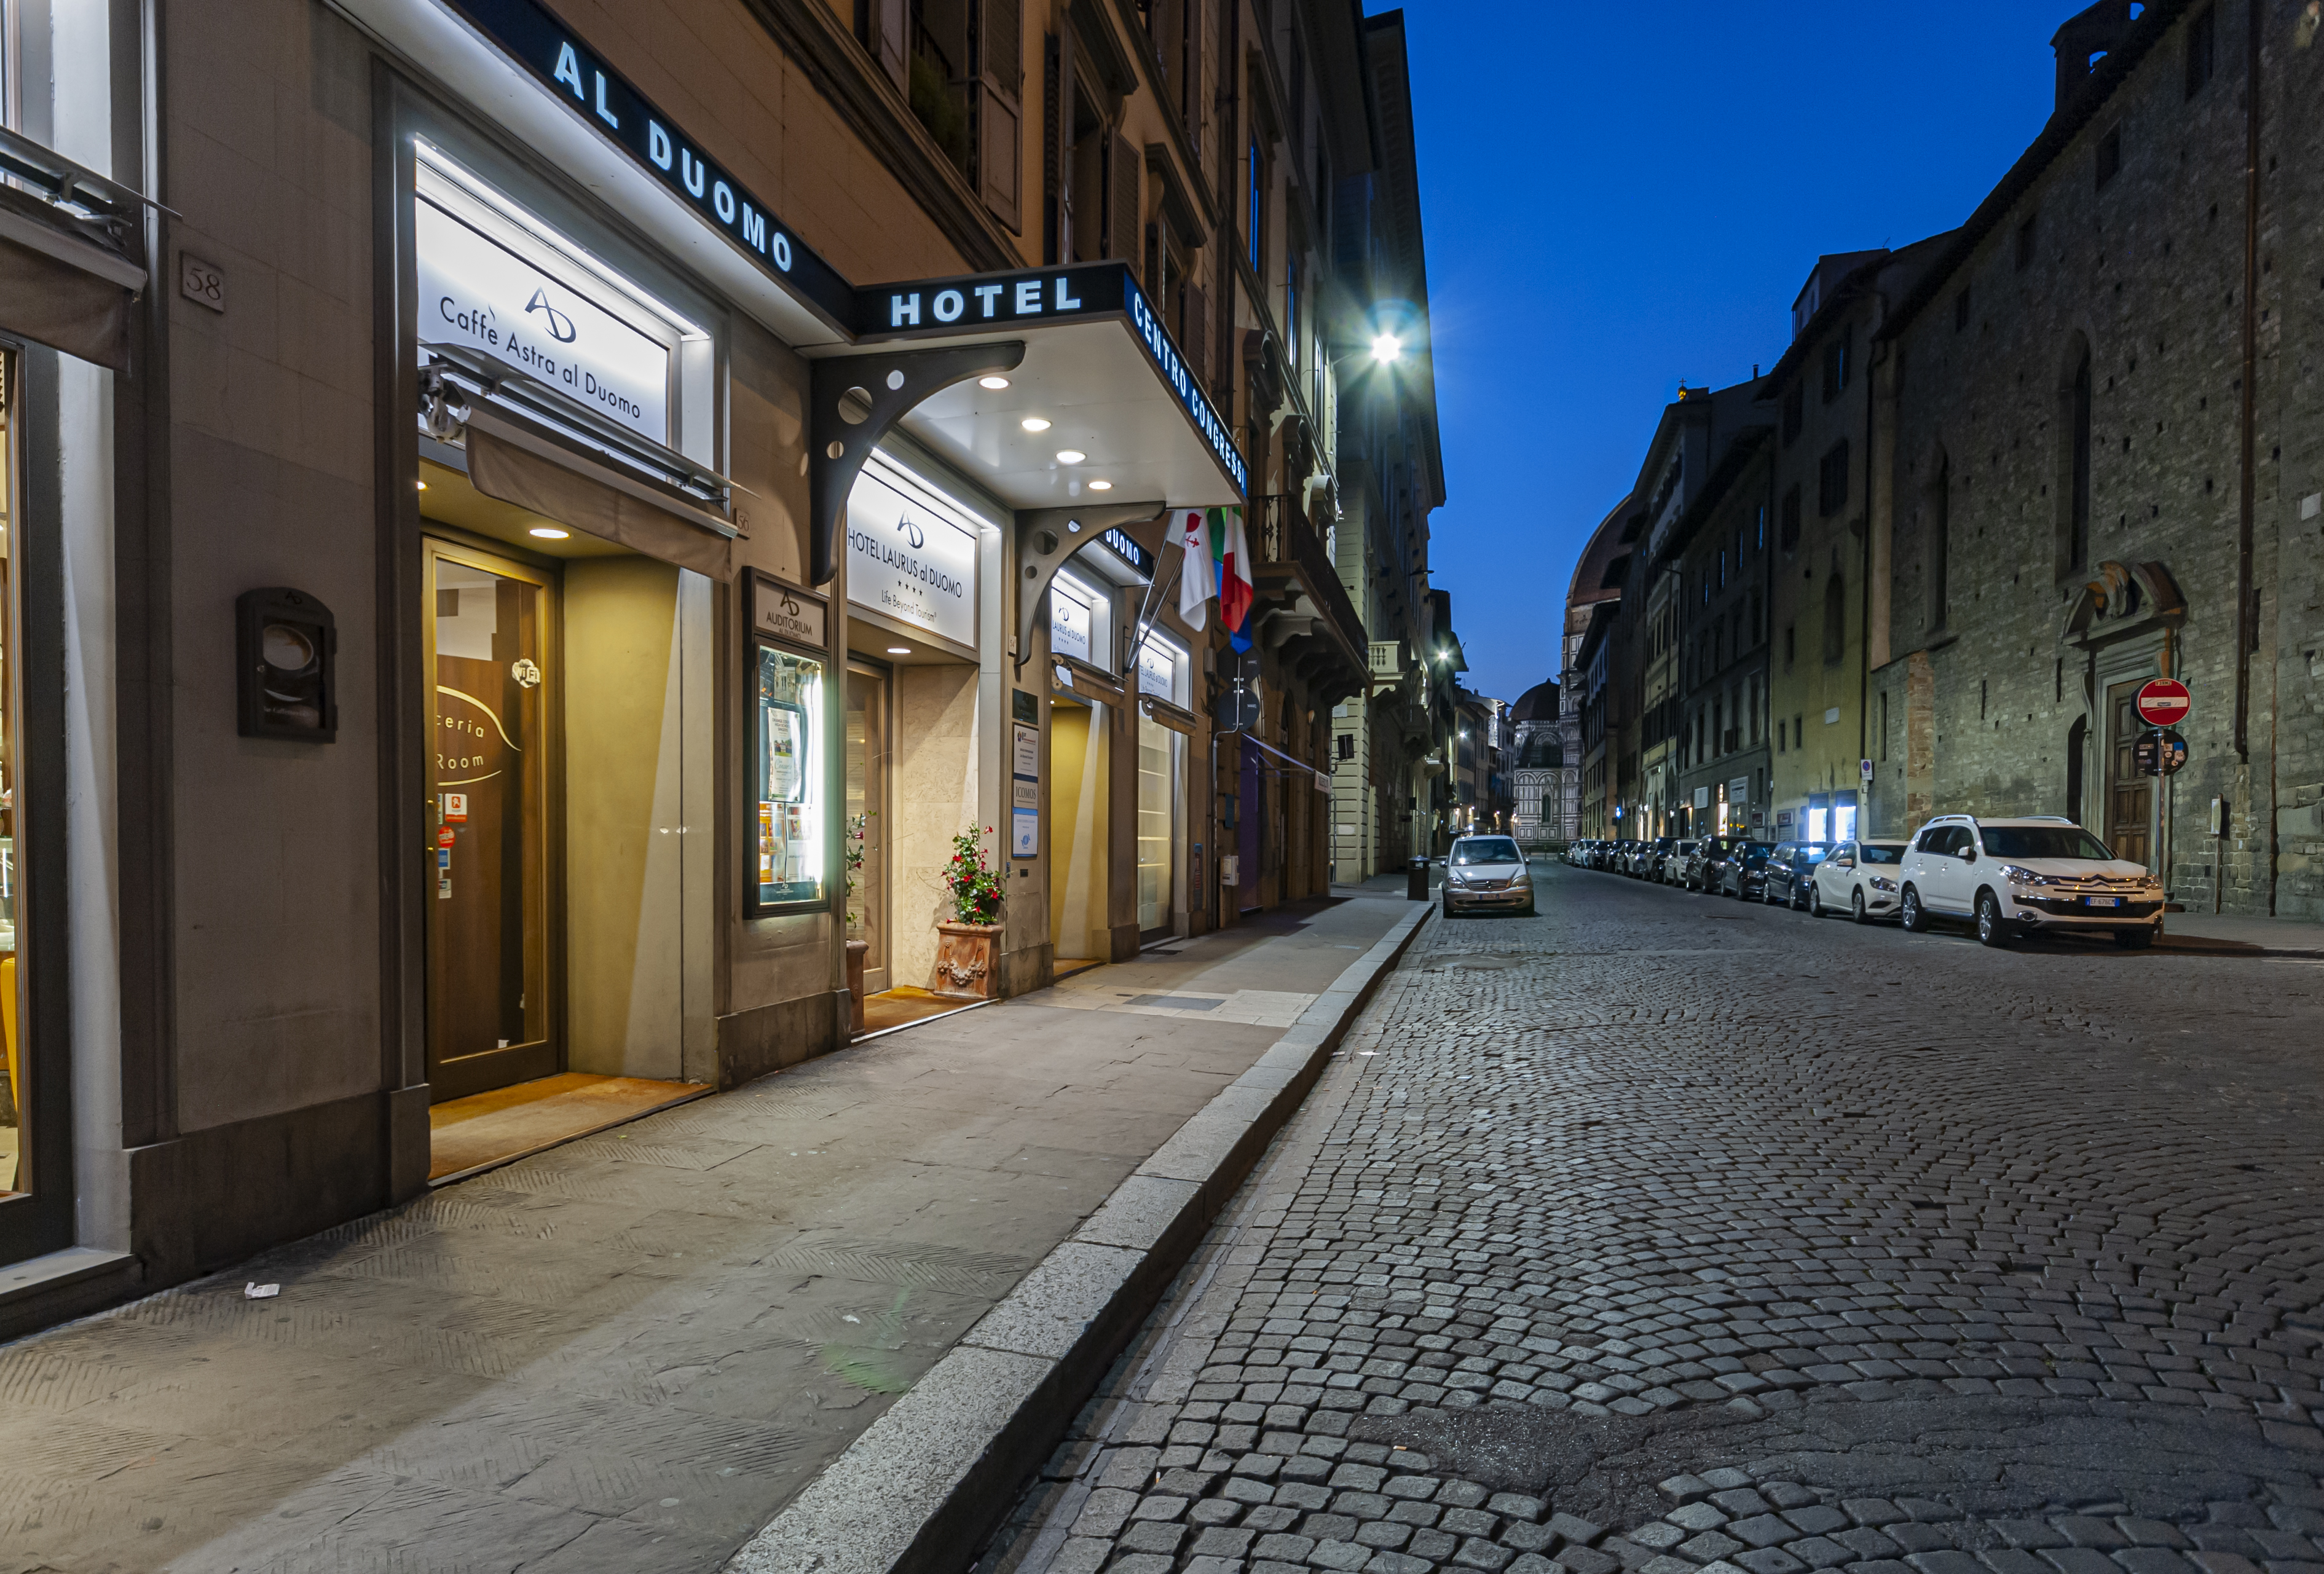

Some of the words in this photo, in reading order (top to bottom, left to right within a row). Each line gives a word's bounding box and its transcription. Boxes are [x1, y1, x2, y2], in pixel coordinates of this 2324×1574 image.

[554, 41, 618, 130] AL
[649, 119, 792, 272] DUOMO
[186, 267, 221, 301] 58
[891, 277, 1081, 327] HOTEL
[440, 296, 498, 345] Caffè
[506, 332, 555, 376] Astra
[563, 364, 578, 387] al
[586, 372, 640, 419] Duomo
[1134, 292, 1186, 397] CENTRO
[1192, 388, 1244, 489] CONGRESSI
[738, 515, 750, 532] 56
[848, 527, 880, 561] HOTEL
[883, 545, 918, 578] LAURUS
[920, 564, 928, 583] al
[930, 568, 963, 598] DUOMO
[881, 589, 891, 605] Life
[893, 594, 915, 613] Beyond
[766, 612, 813, 636] AUDITORIUM
[1052, 620, 1067, 636] LAURUS
[1071, 629, 1086, 645] DUOMO
[1015, 786, 1036, 800] ICOMOS
